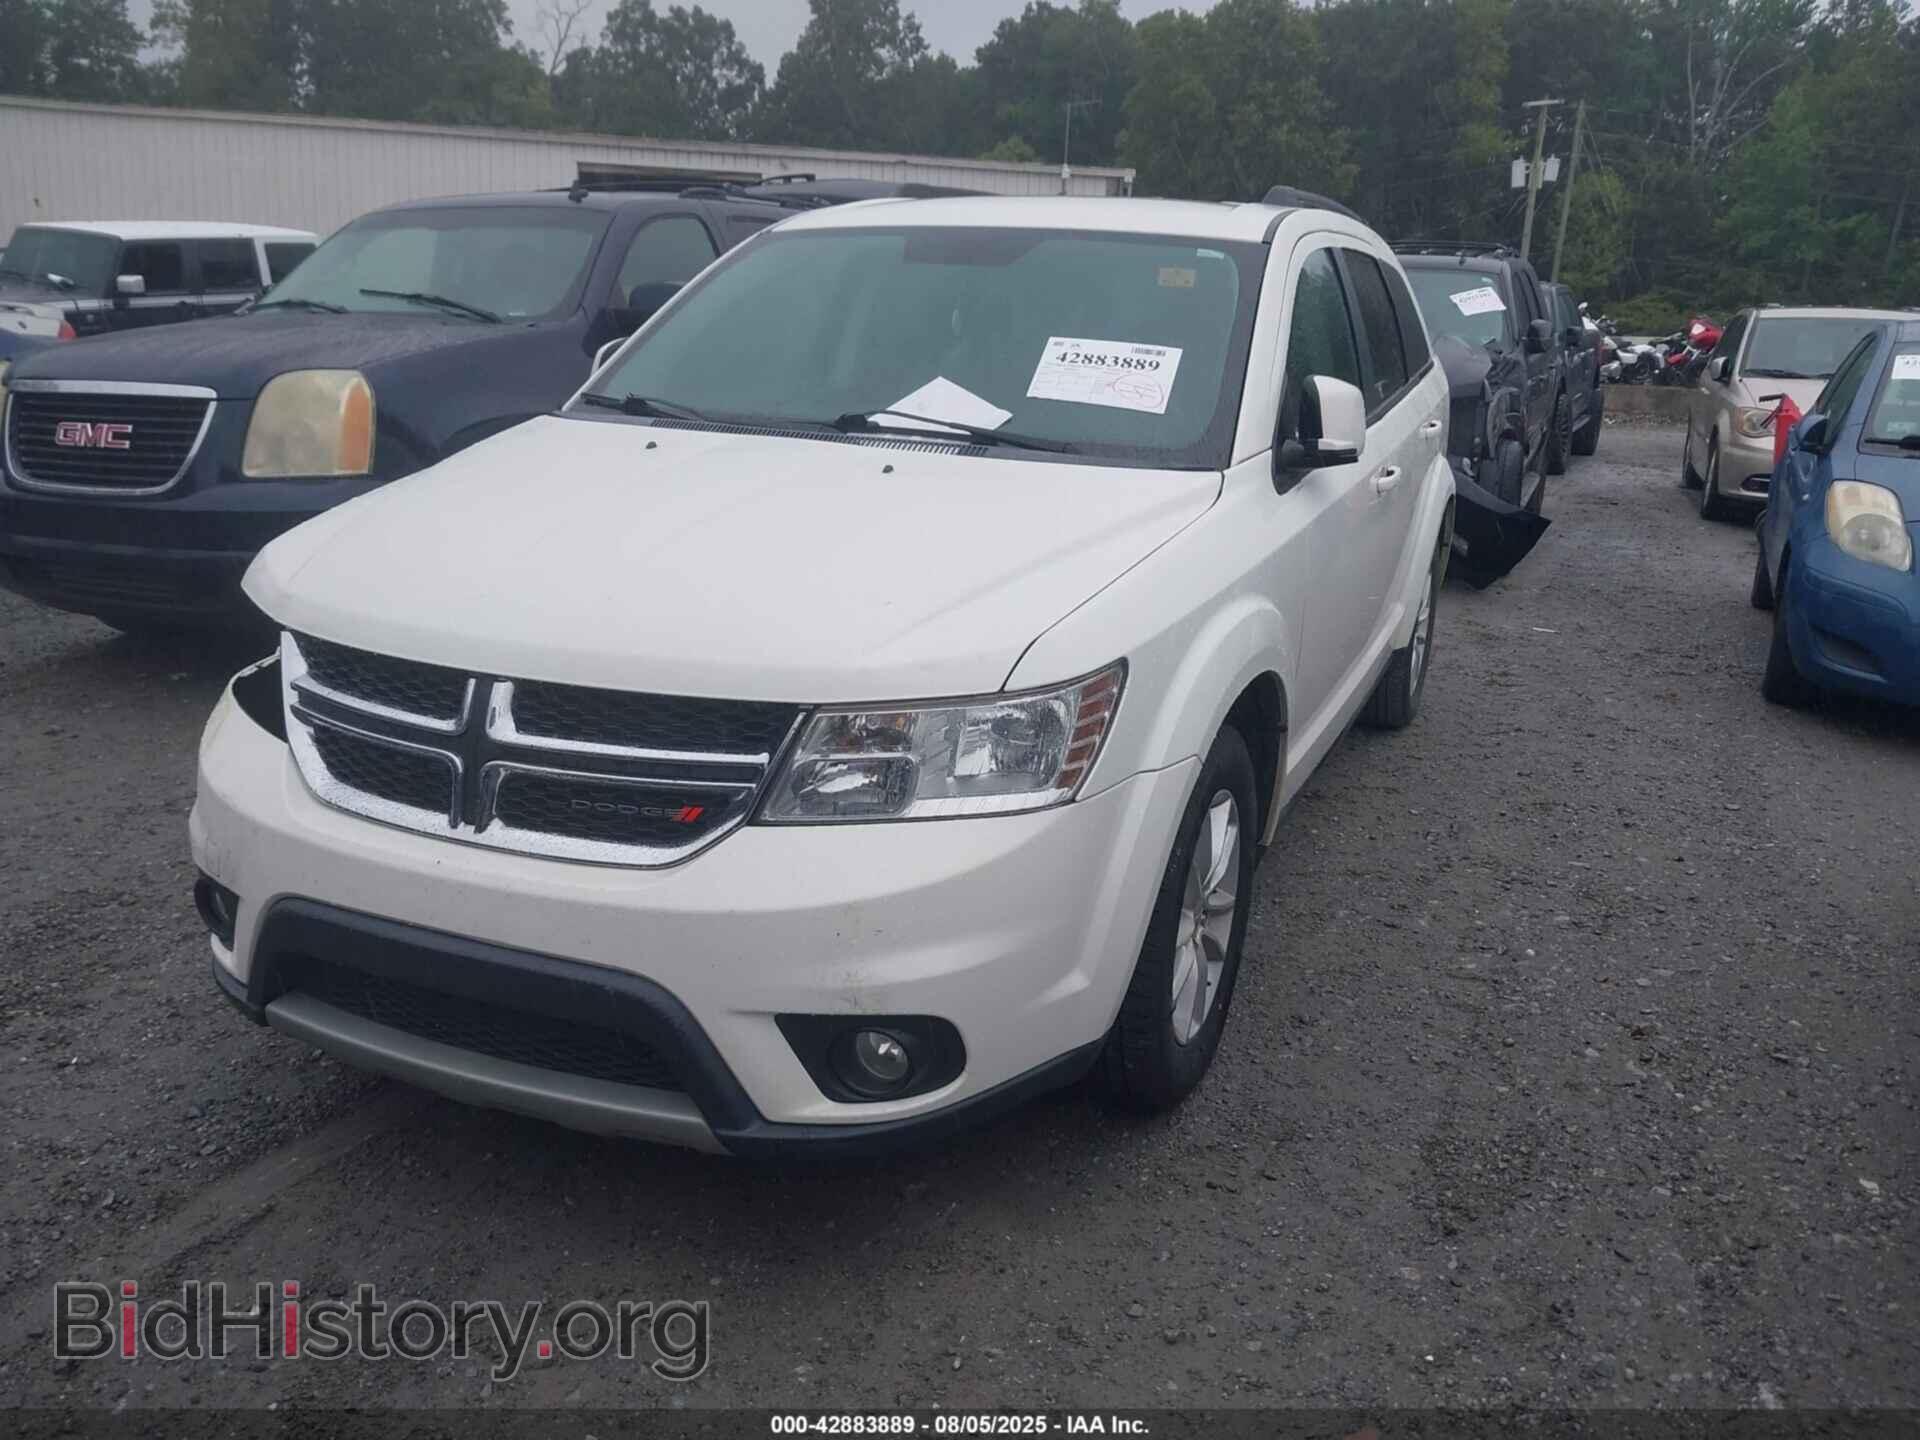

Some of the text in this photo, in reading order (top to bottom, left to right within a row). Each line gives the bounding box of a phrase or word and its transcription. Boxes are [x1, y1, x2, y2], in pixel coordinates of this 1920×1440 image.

[1056, 351, 1161, 371] 42883889
[55, 422, 133, 448] GMC
[571, 799, 685, 821] DODGE
